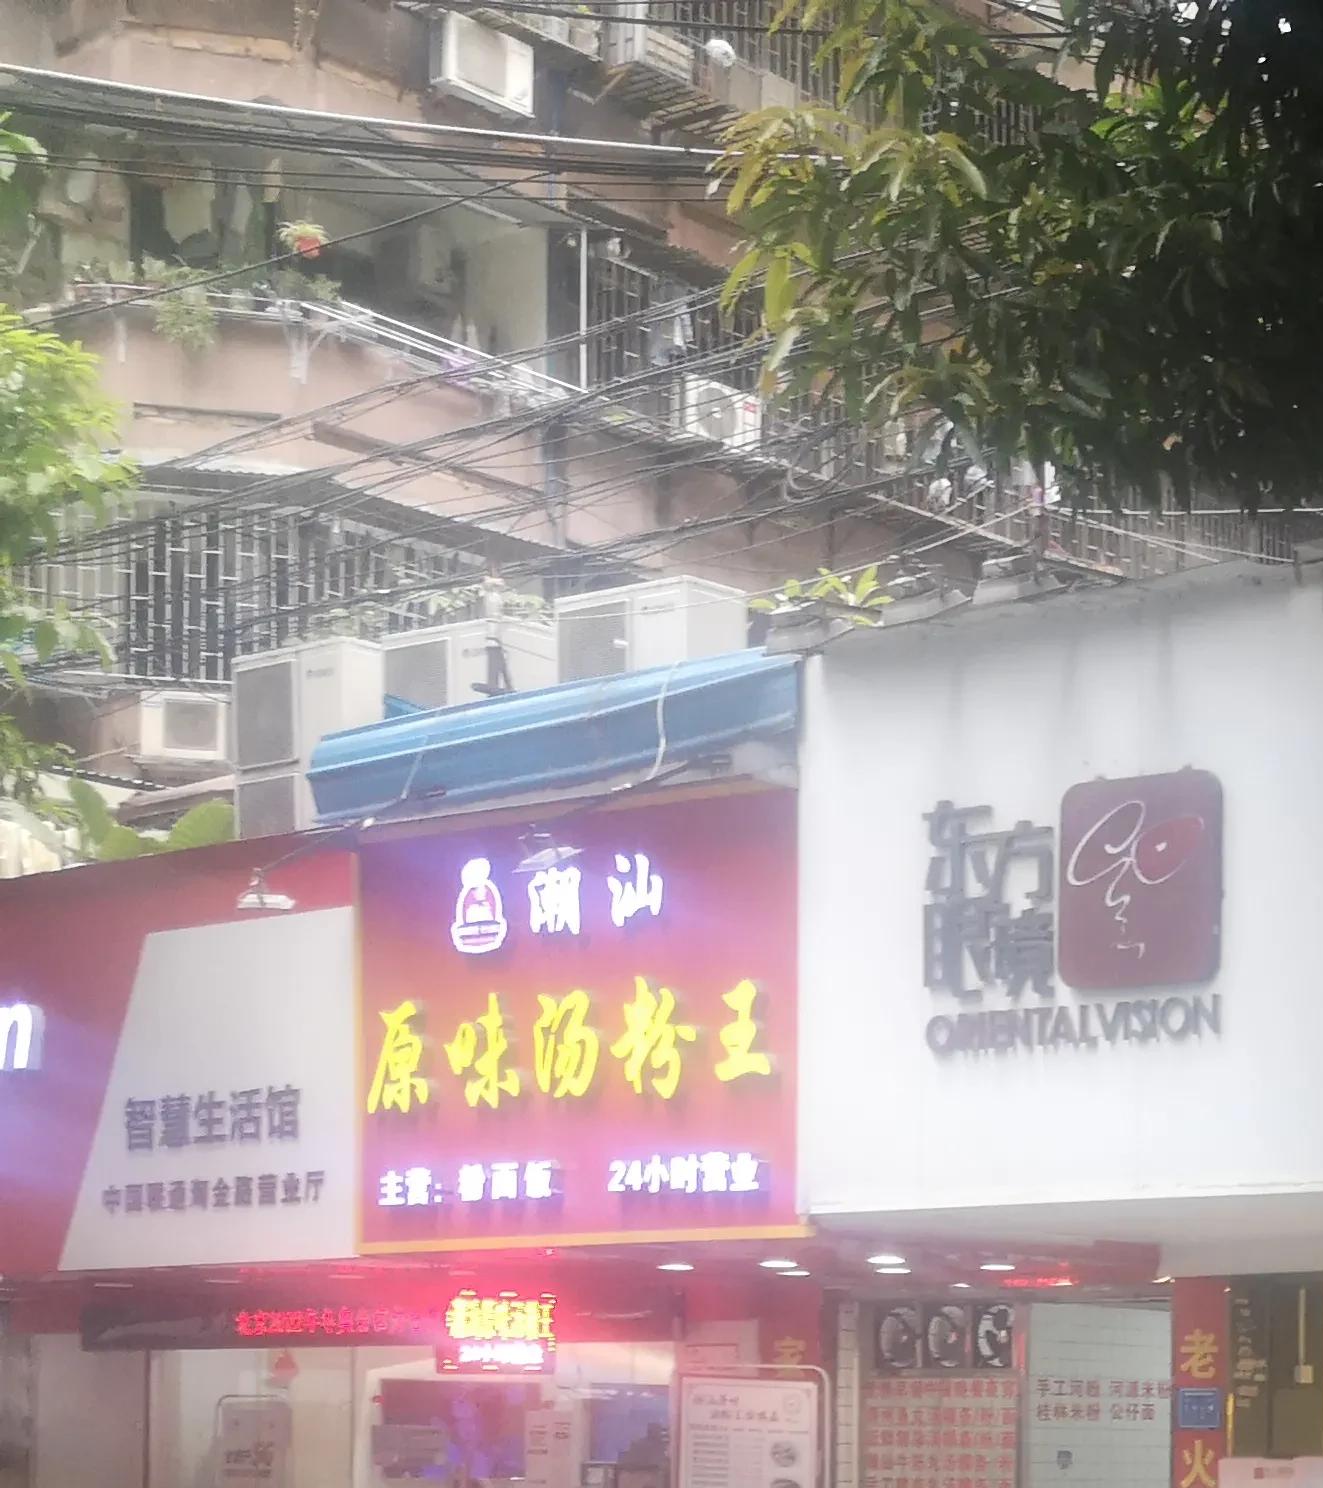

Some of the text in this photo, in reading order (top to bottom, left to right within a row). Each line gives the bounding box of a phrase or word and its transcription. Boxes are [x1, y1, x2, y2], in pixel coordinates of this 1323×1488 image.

[528, 854, 663, 934] 潮汕
[922, 799, 1054, 903] 东方
[923, 899, 1055, 1001] 眼镜
[367, 976, 771, 1113] 原味汤粉王
[125, 1084, 301, 1151] 智慧生活馆
